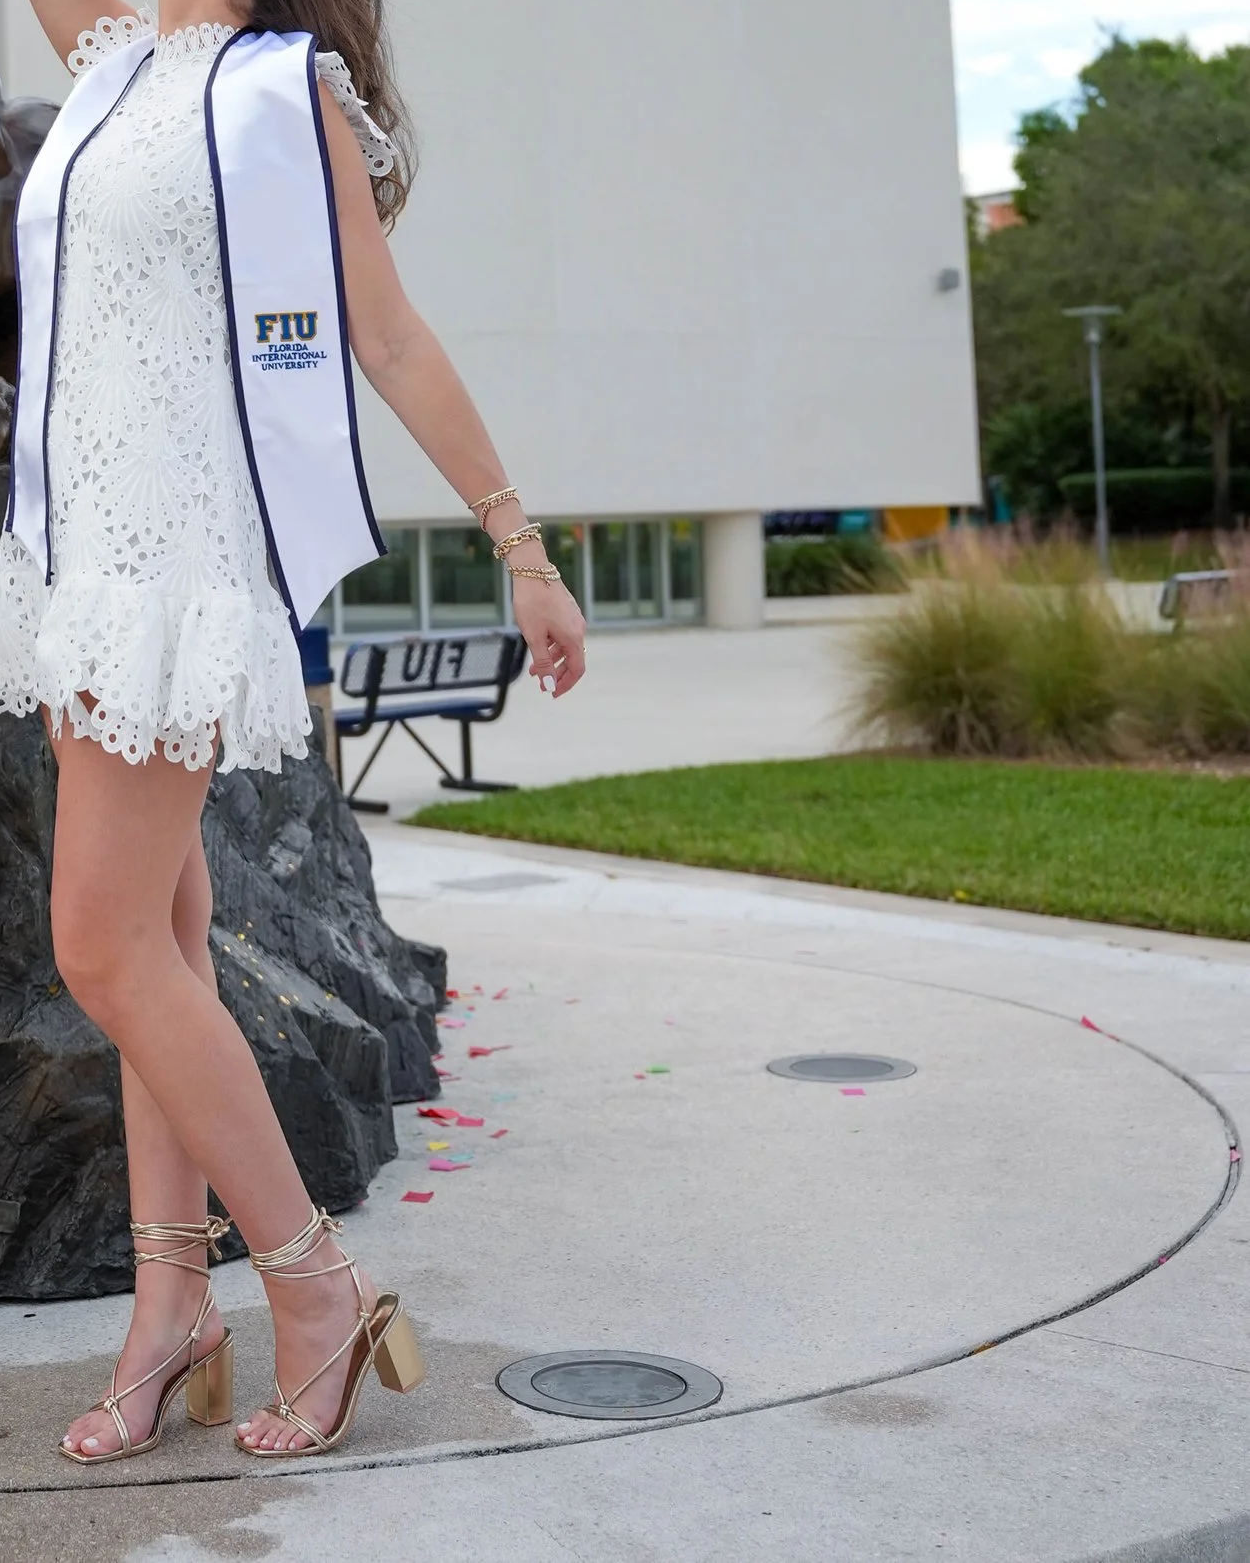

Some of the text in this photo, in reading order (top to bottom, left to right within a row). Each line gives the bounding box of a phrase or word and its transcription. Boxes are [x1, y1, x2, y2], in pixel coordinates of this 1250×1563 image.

[254, 311, 318, 343] FIU
[268, 343, 309, 353] FLORIDA
[252, 351, 327, 363] INTERNATIONAL
[261, 361, 319, 371] UNIVERSITY
